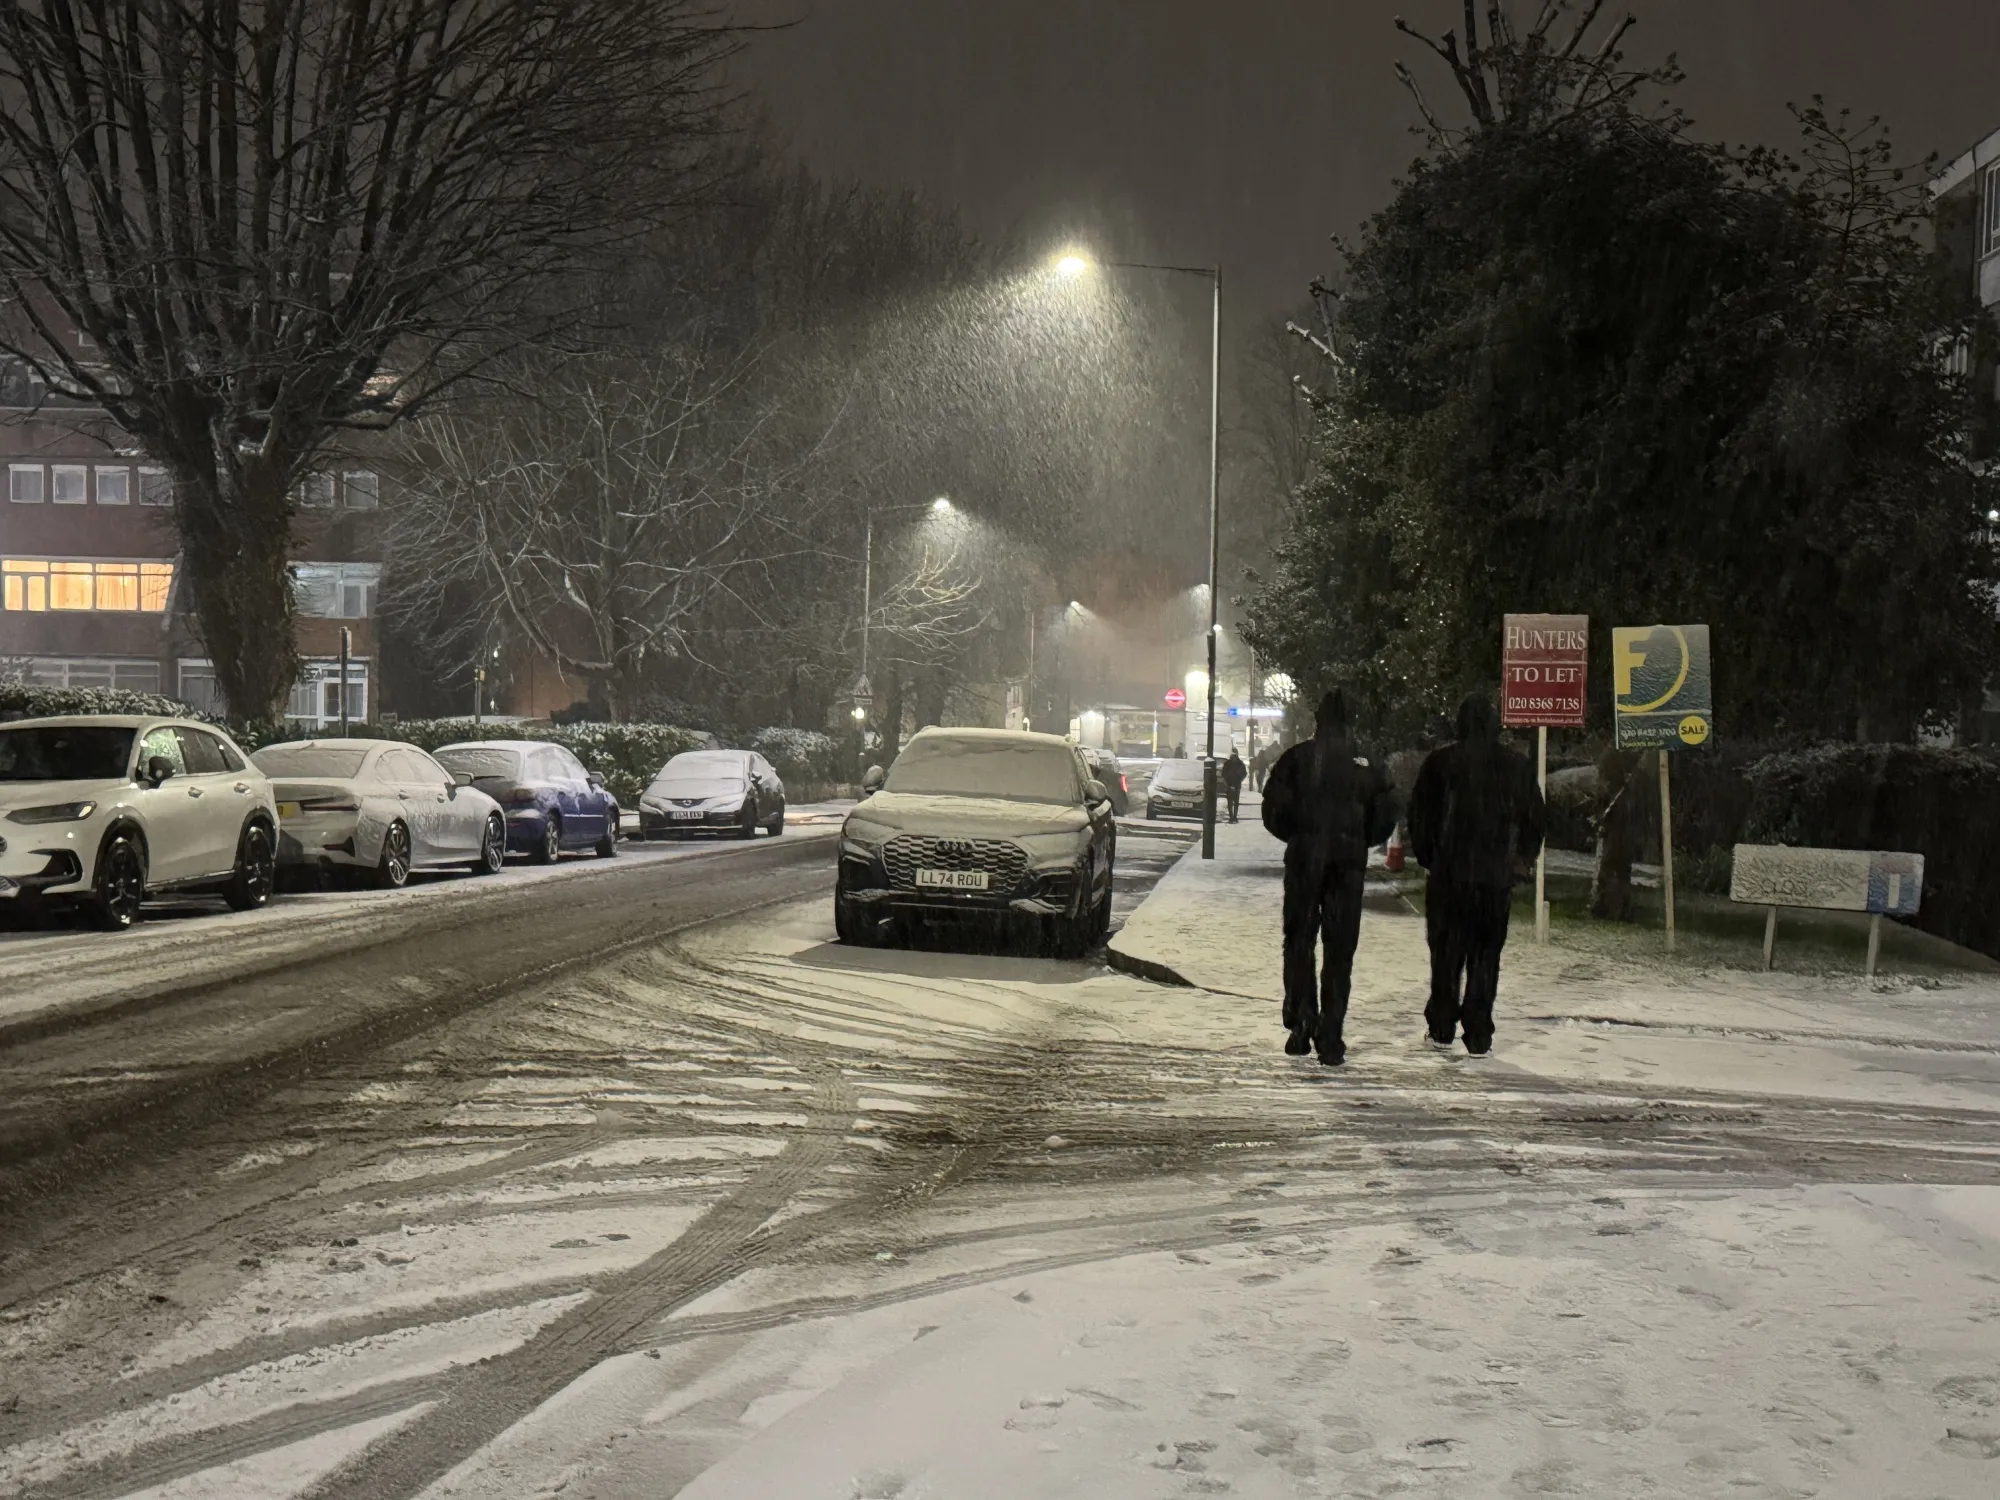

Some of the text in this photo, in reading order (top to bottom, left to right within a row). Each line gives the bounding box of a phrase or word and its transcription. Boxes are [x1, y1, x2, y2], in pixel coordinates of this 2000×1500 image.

[1506, 626, 1586, 650] HUNTERS
[1512, 667, 1577, 683] TO LET
[1508, 697, 1580, 710] 020 8368 7138
[921, 871, 953, 885] LL74
